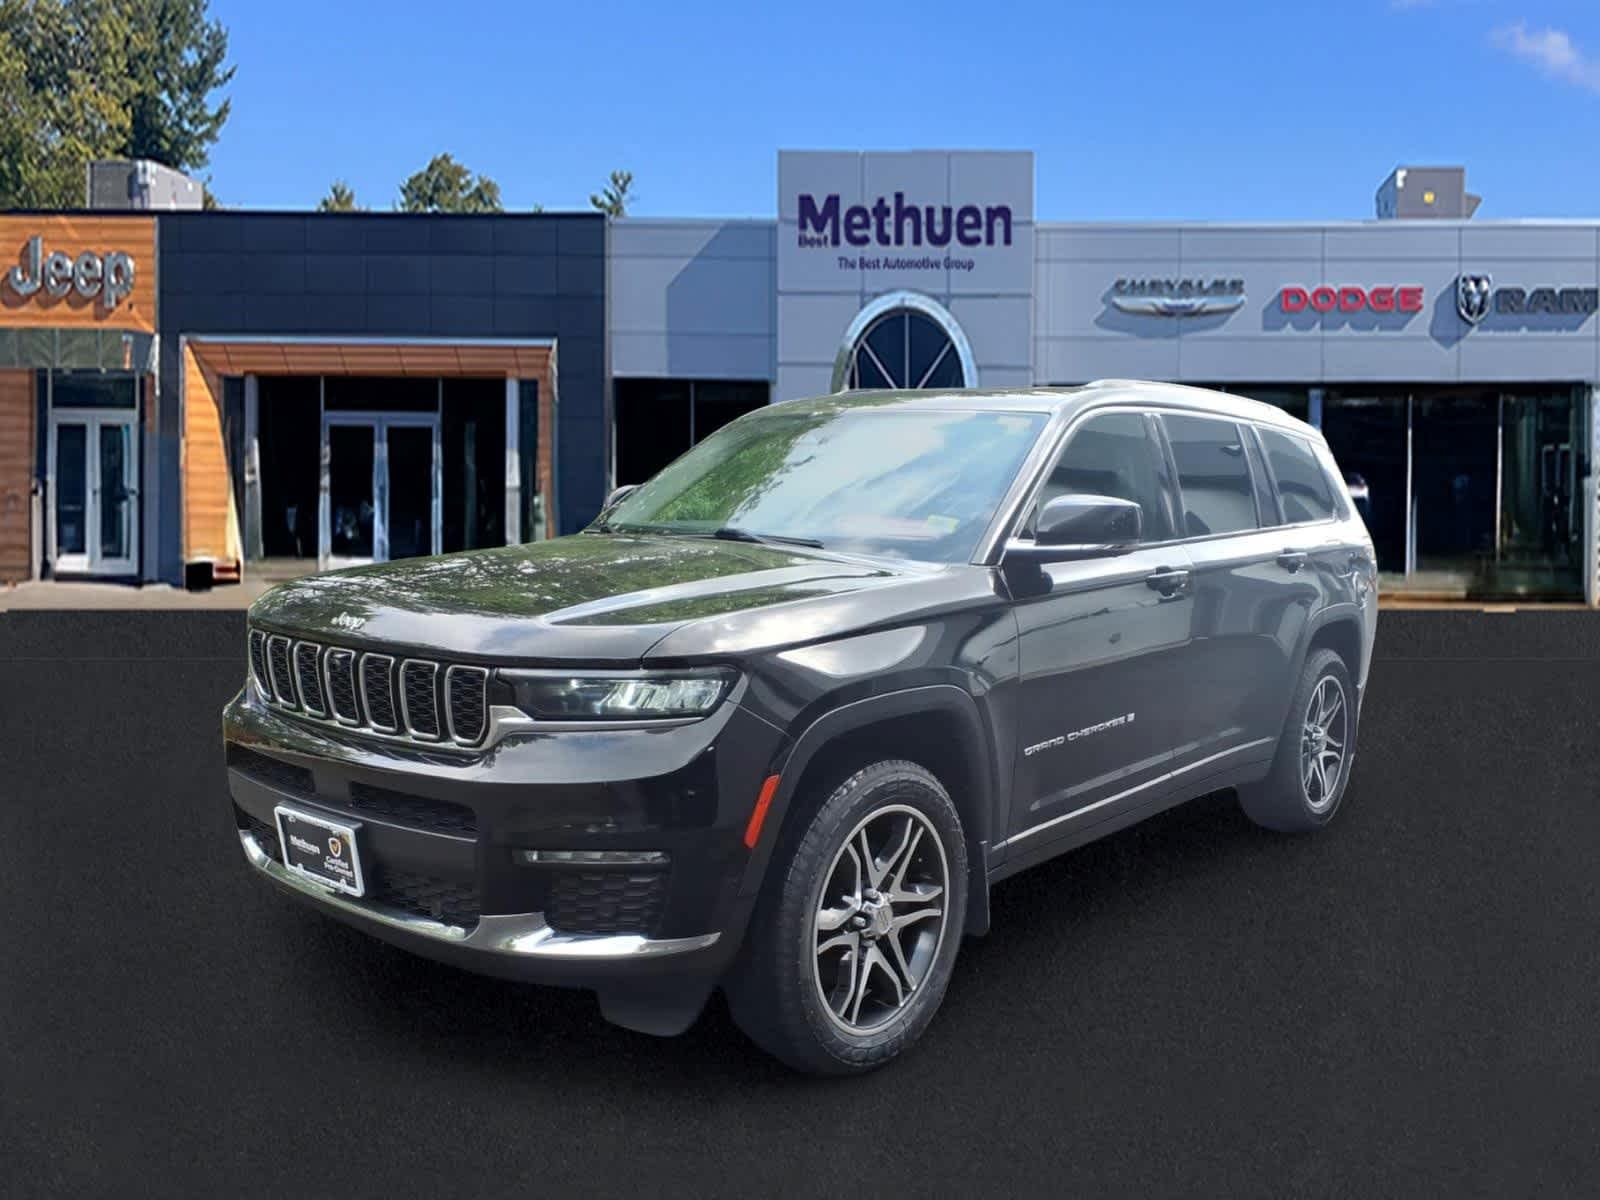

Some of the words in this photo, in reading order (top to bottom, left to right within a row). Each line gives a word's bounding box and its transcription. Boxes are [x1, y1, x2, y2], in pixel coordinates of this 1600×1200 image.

[798, 192, 1012, 246] Methuen
[9, 235, 134, 309] Jeep
[838, 256, 857, 270] The
[859, 256, 880, 270] Best
[882, 256, 941, 270] Automotive
[943, 256, 975, 272] Group
[1282, 287, 1424, 312] DODGE
[1495, 287, 1599, 315] RAM
[1024, 735, 1065, 756] GRAND
[1067, 715, 1125, 741] CHEROKEE
